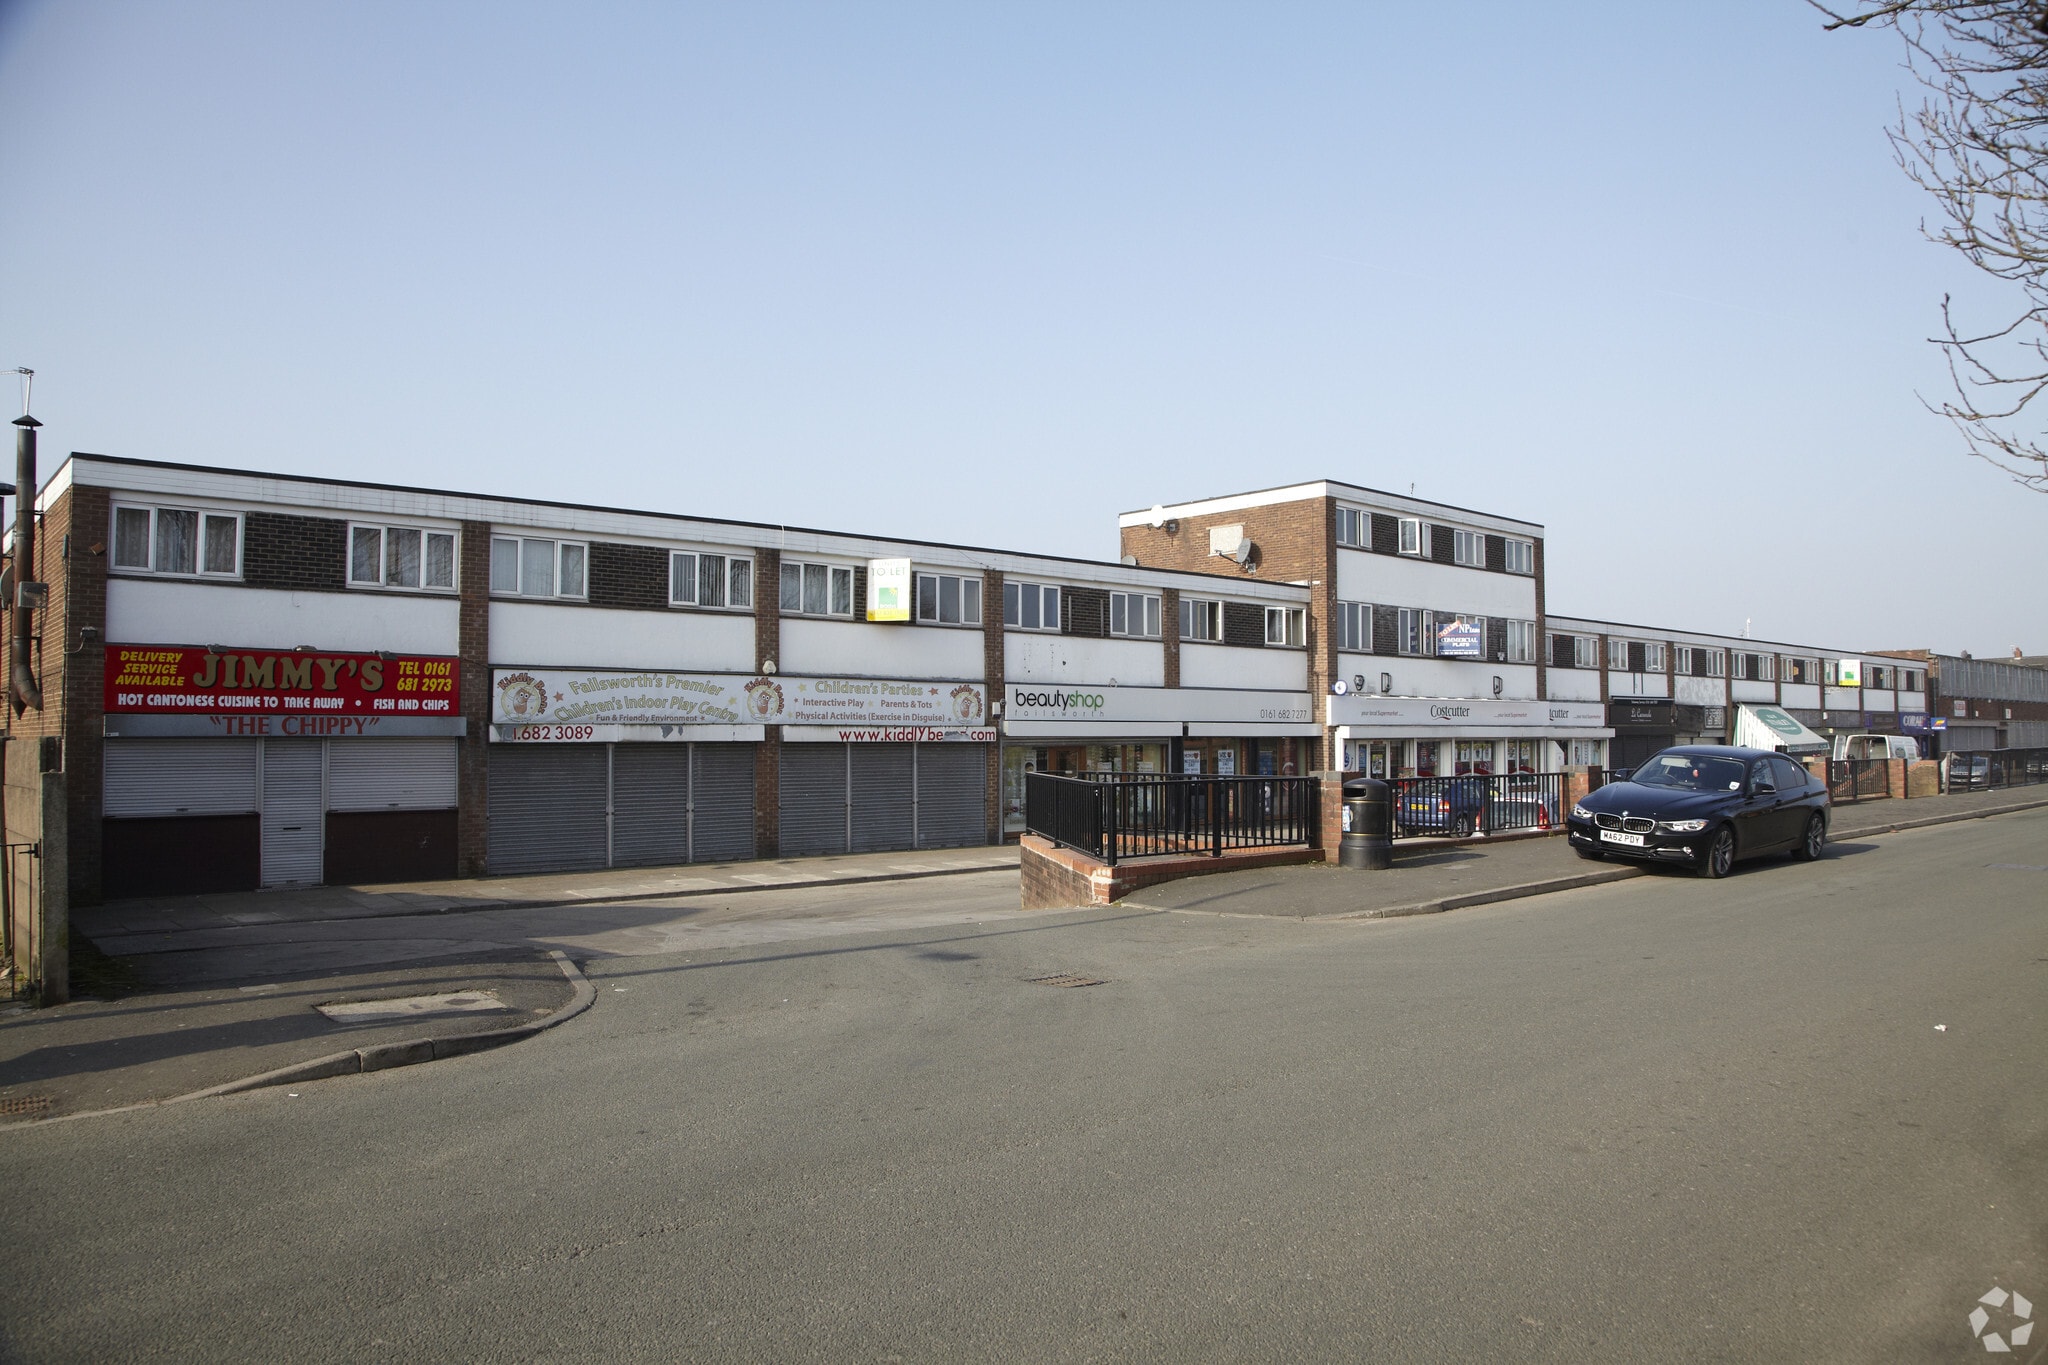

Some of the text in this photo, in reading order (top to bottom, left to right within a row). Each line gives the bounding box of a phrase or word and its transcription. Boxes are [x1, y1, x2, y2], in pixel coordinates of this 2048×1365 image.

[120, 651, 183, 663] DELIVERY
[123, 663, 178, 674] SERVICE
[193, 654, 384, 692] JIMMY'S
[399, 662, 451, 676] TEL 0161
[115, 675, 185, 686] AVAILABLE
[397, 677, 452, 692] 681 2973
[497, 672, 535, 690] Kiddly
[568, 673, 725, 696] Failsworth's Premier
[815, 680, 923, 696] Children's Parties
[118, 693, 449, 711] HOT CANTONESE CUISINE TO TAKE AWAY FISH AND CHIPS
[802, 697, 932, 709] Interactive Play Parents & Tots
[1015, 688, 1104, 712] beautyshop
[553, 694, 739, 722] Children's Indoor Play Centre
[1260, 709, 1307, 719] 0161 682 7277
[1430, 704, 1470, 718] Costcutter
[619, 714, 649, 722] Friendly
[650, 714, 698, 722] Environment
[795, 711, 945, 723] Physical Activities (Exercise in Disguise)
[1903, 716, 1923, 726] CORAL
[555, 725, 593, 740] 3089
[1603, 831, 1623, 842] MA62
